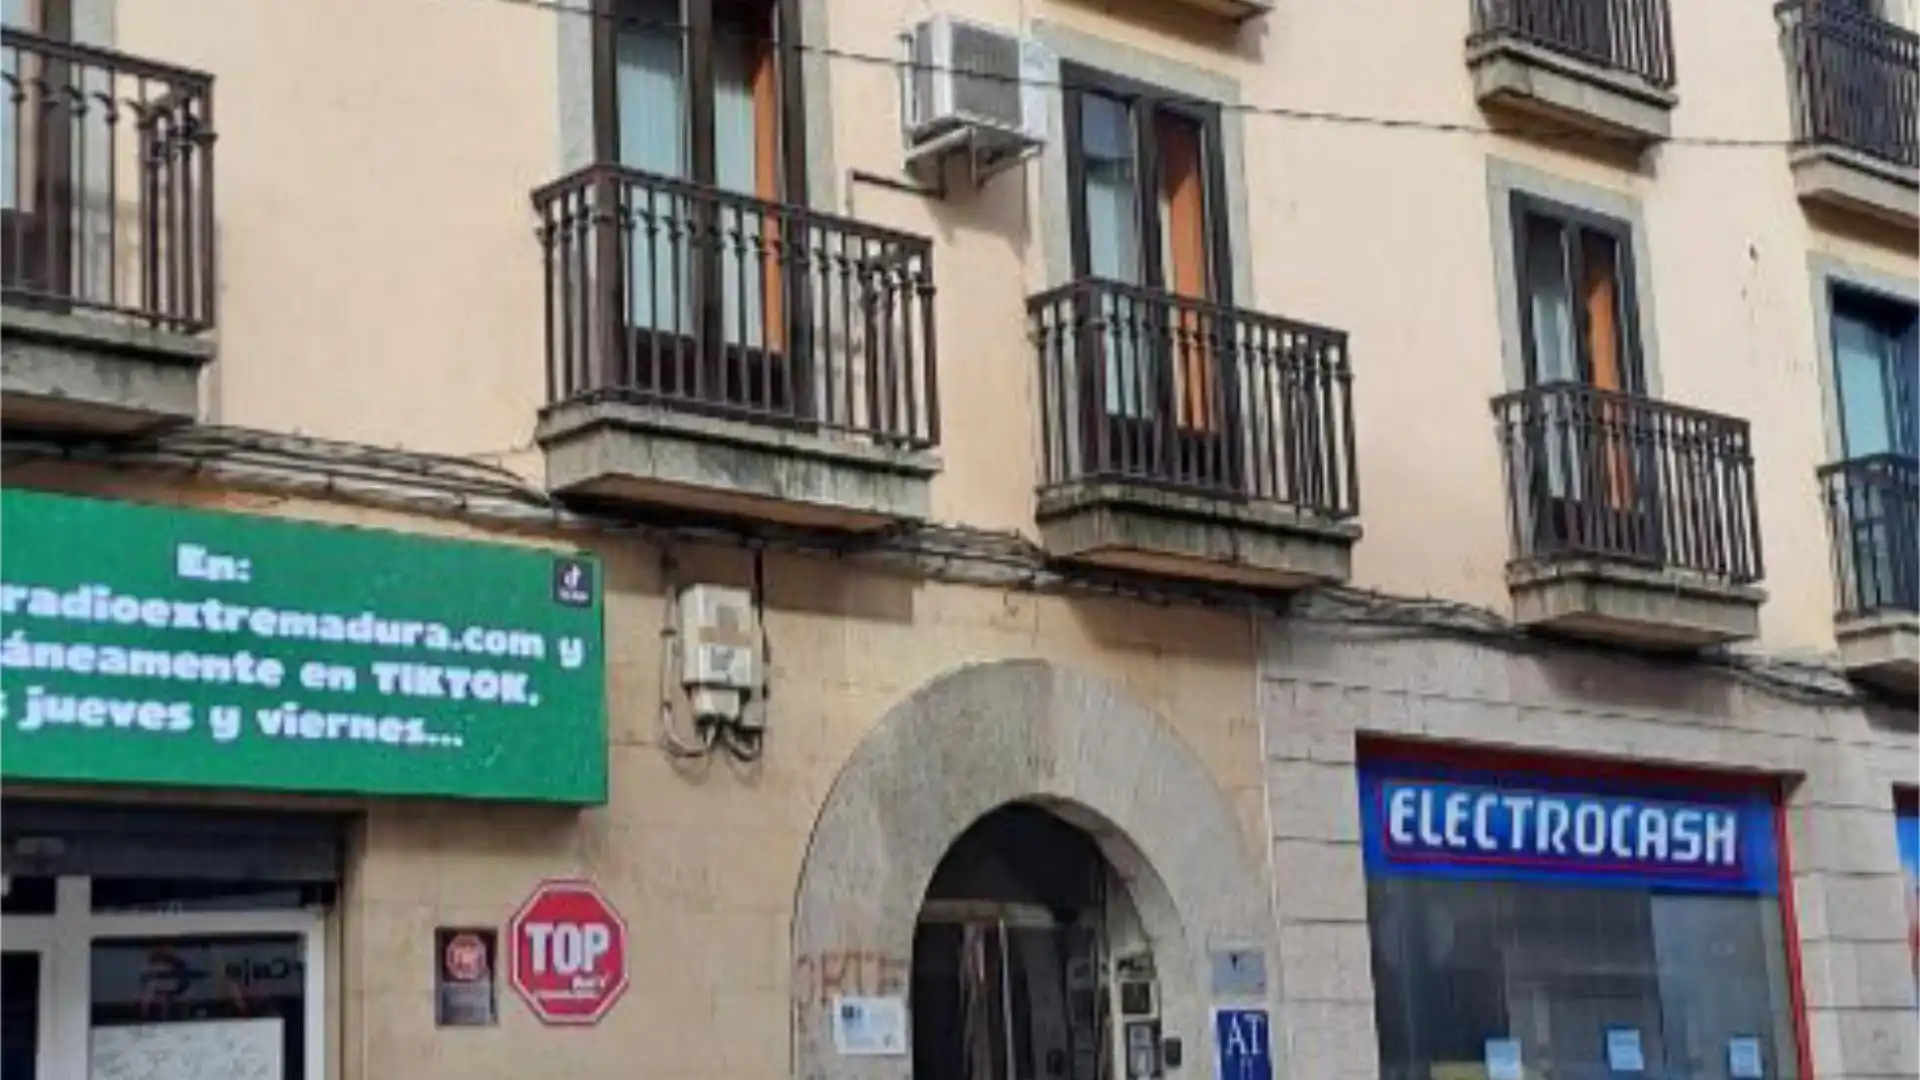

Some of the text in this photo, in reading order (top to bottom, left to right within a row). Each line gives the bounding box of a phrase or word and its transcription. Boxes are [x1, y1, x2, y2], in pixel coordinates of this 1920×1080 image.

[176, 543, 251, 582] En:
[558, 637, 584, 668] y
[300, 661, 357, 693] en
[17, 684, 194, 731] jueves
[209, 704, 242, 742] y
[256, 701, 464, 749] viernes...
[1388, 787, 1736, 866] ELECTROCASH
[523, 921, 611, 976] TOP
